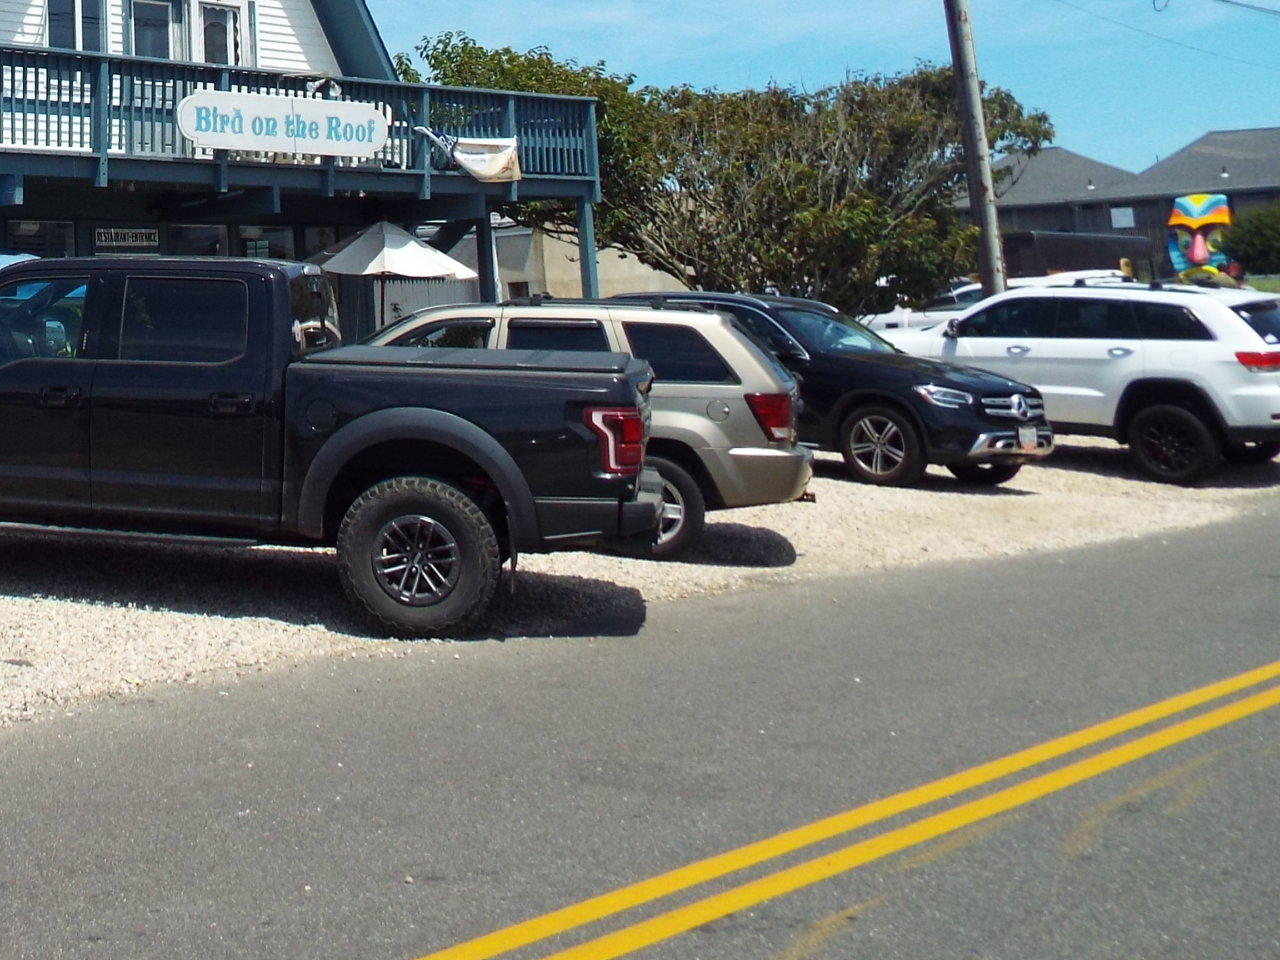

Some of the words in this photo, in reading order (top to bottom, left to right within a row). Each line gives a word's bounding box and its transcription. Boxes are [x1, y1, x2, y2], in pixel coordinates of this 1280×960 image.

[194, 105, 244, 135] Bird
[251, 115, 278, 137] on
[284, 112, 320, 140] the
[325, 115, 376, 143] Roof
